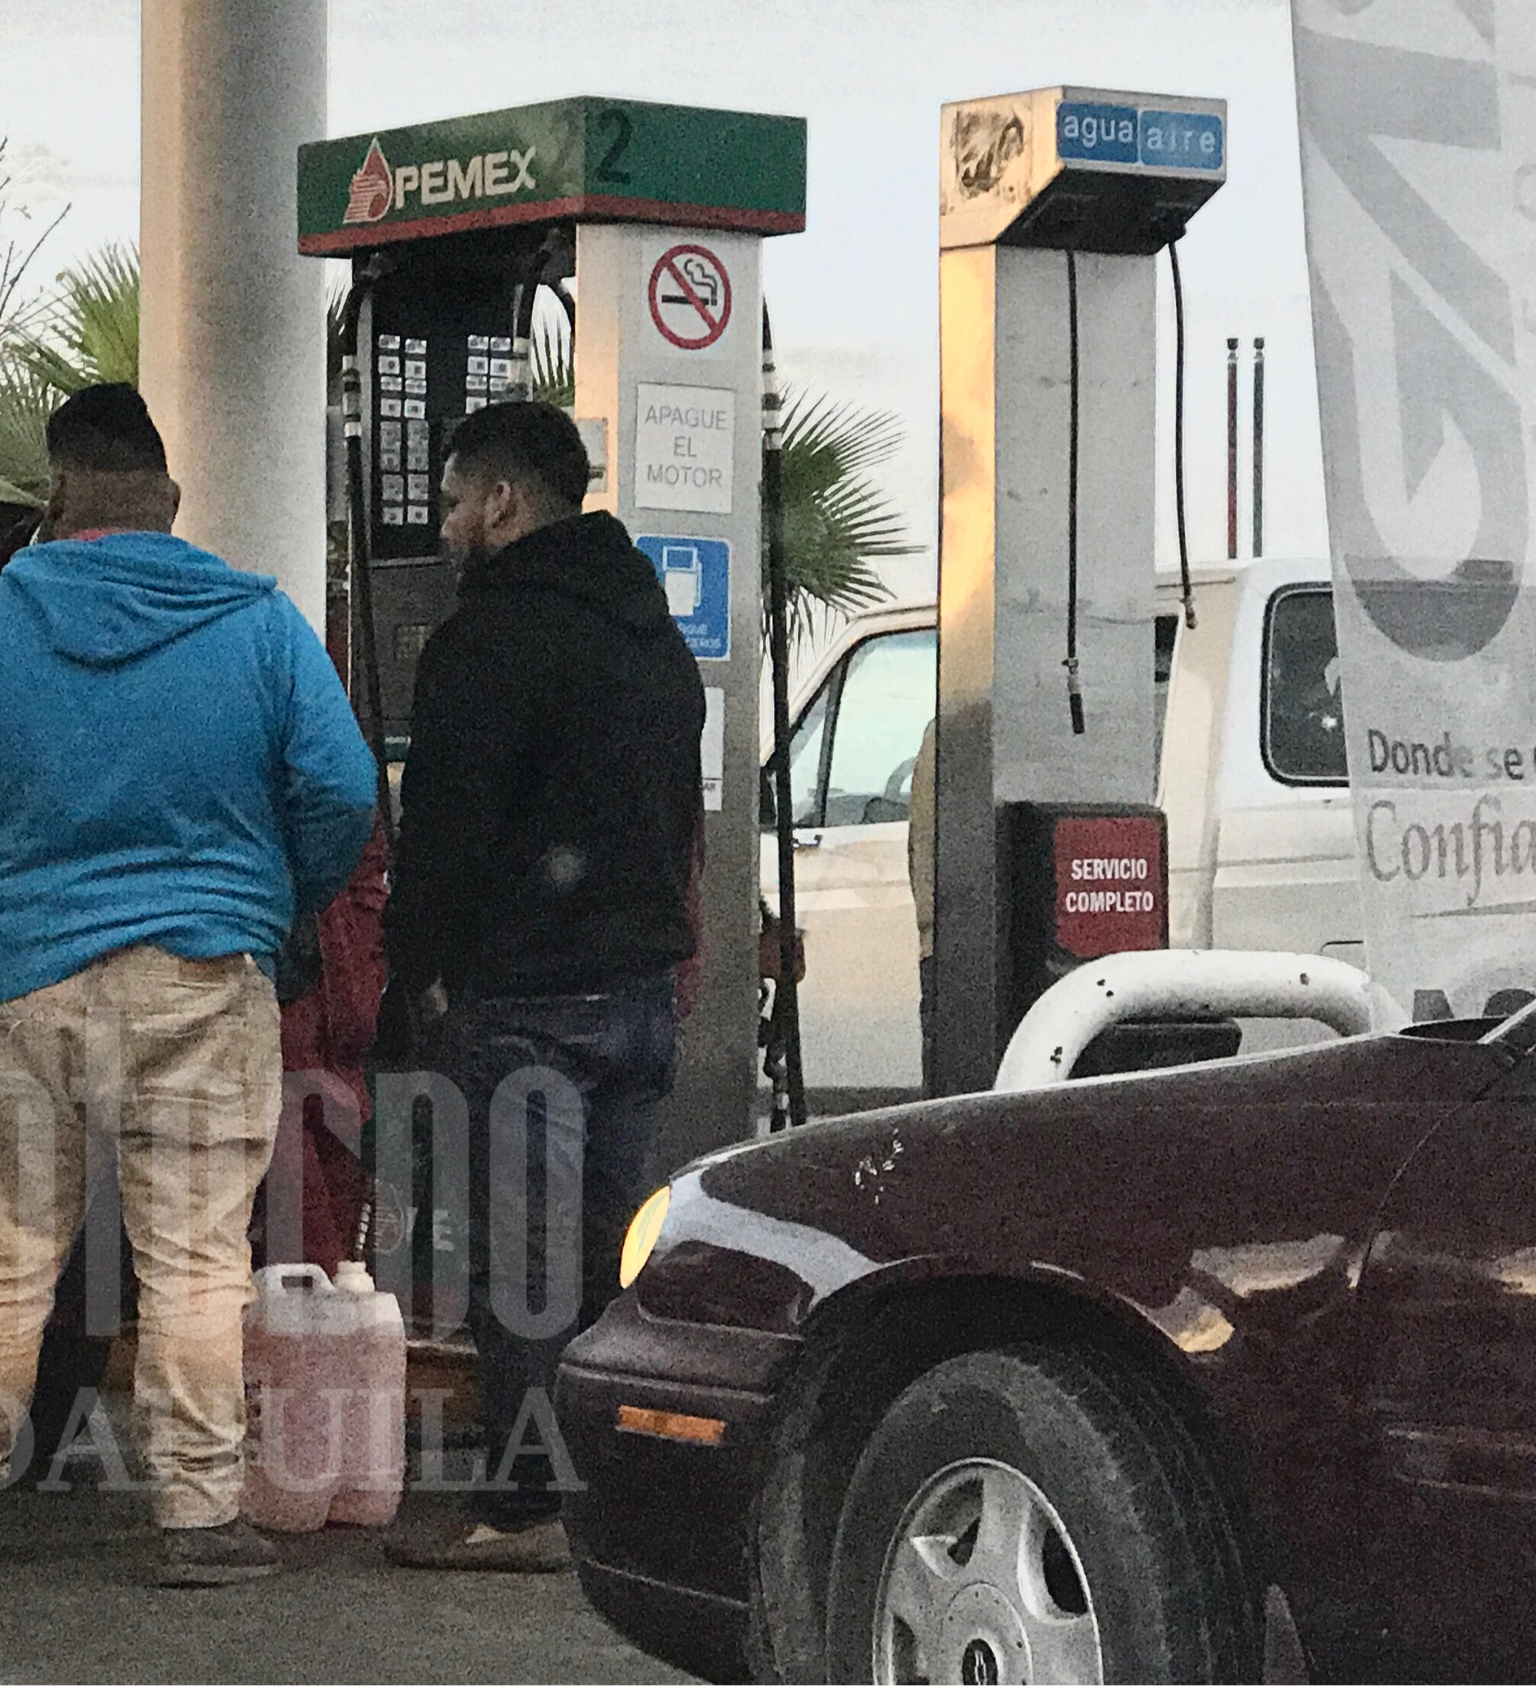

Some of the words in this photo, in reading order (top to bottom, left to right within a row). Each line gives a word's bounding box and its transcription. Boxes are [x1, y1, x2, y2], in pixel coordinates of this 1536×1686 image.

[1064, 114, 1134, 149] agua
[1146, 126, 1216, 154] aire
[597, 107, 633, 185] 2
[394, 146, 537, 210] PEMEX
[645, 404, 728, 431] APAGUE
[673, 436, 698, 458] EL
[647, 463, 723, 488] MOTOR
[1368, 728, 1474, 779] Donde
[1485, 747, 1524, 781] se
[1070, 858, 1148, 880] SERVICIO
[1065, 890, 1154, 913] COMPLETO
